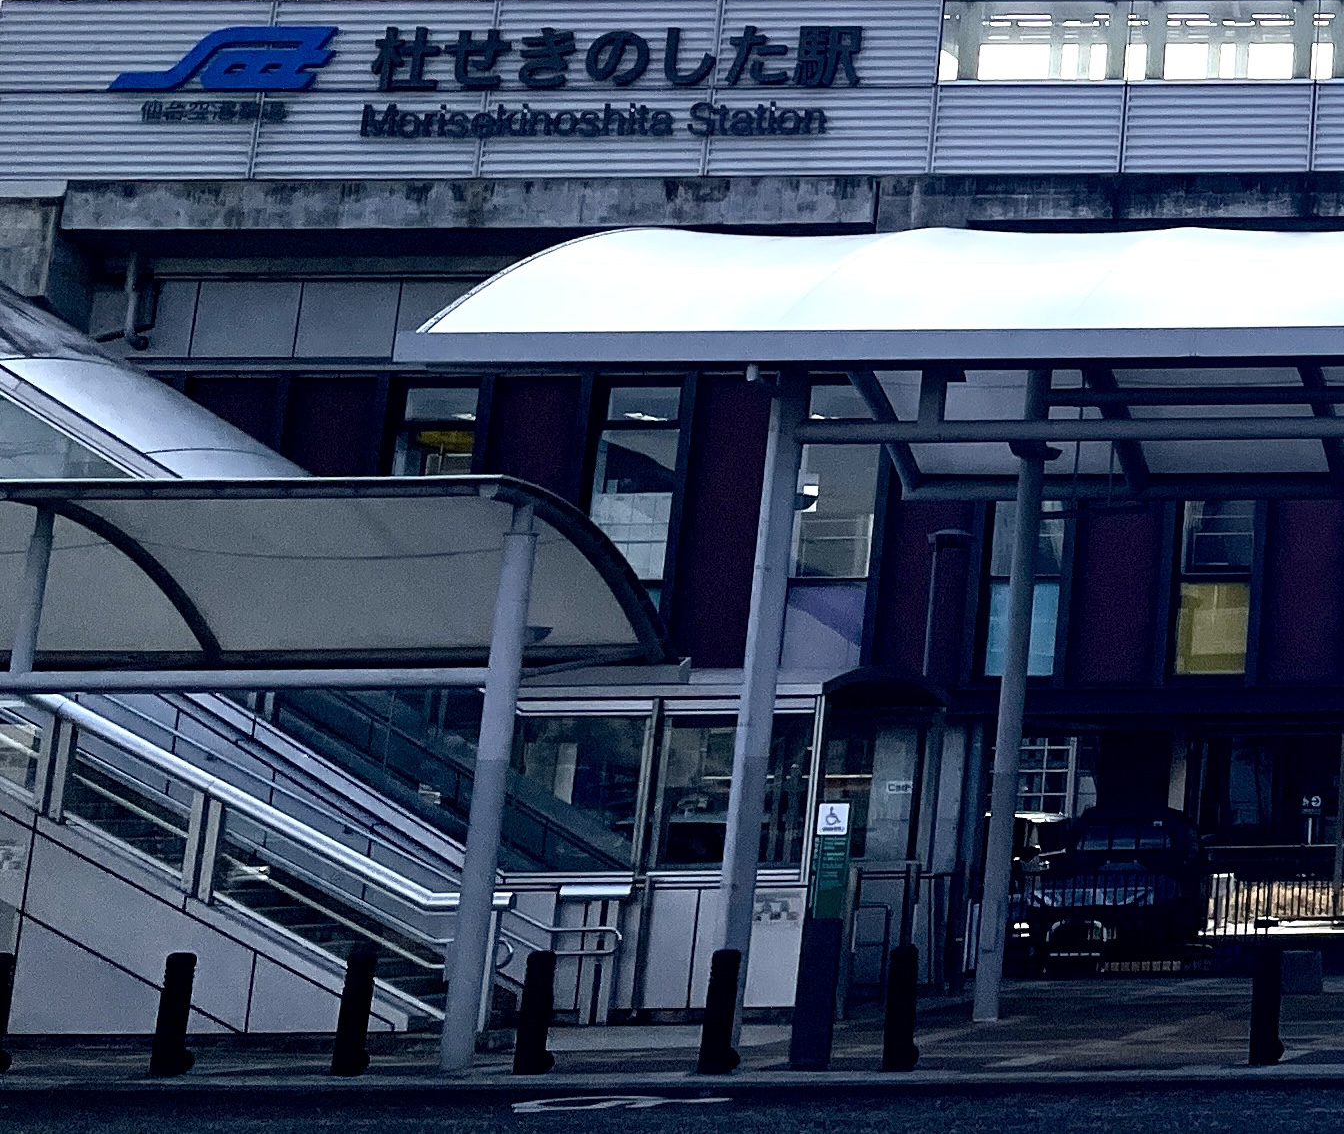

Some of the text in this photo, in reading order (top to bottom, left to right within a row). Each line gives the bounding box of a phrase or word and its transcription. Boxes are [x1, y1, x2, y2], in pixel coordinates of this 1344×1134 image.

[372, 26, 863, 91] 杜せきのした駅
[360, 102, 828, 138] Morisekinoshita Station
